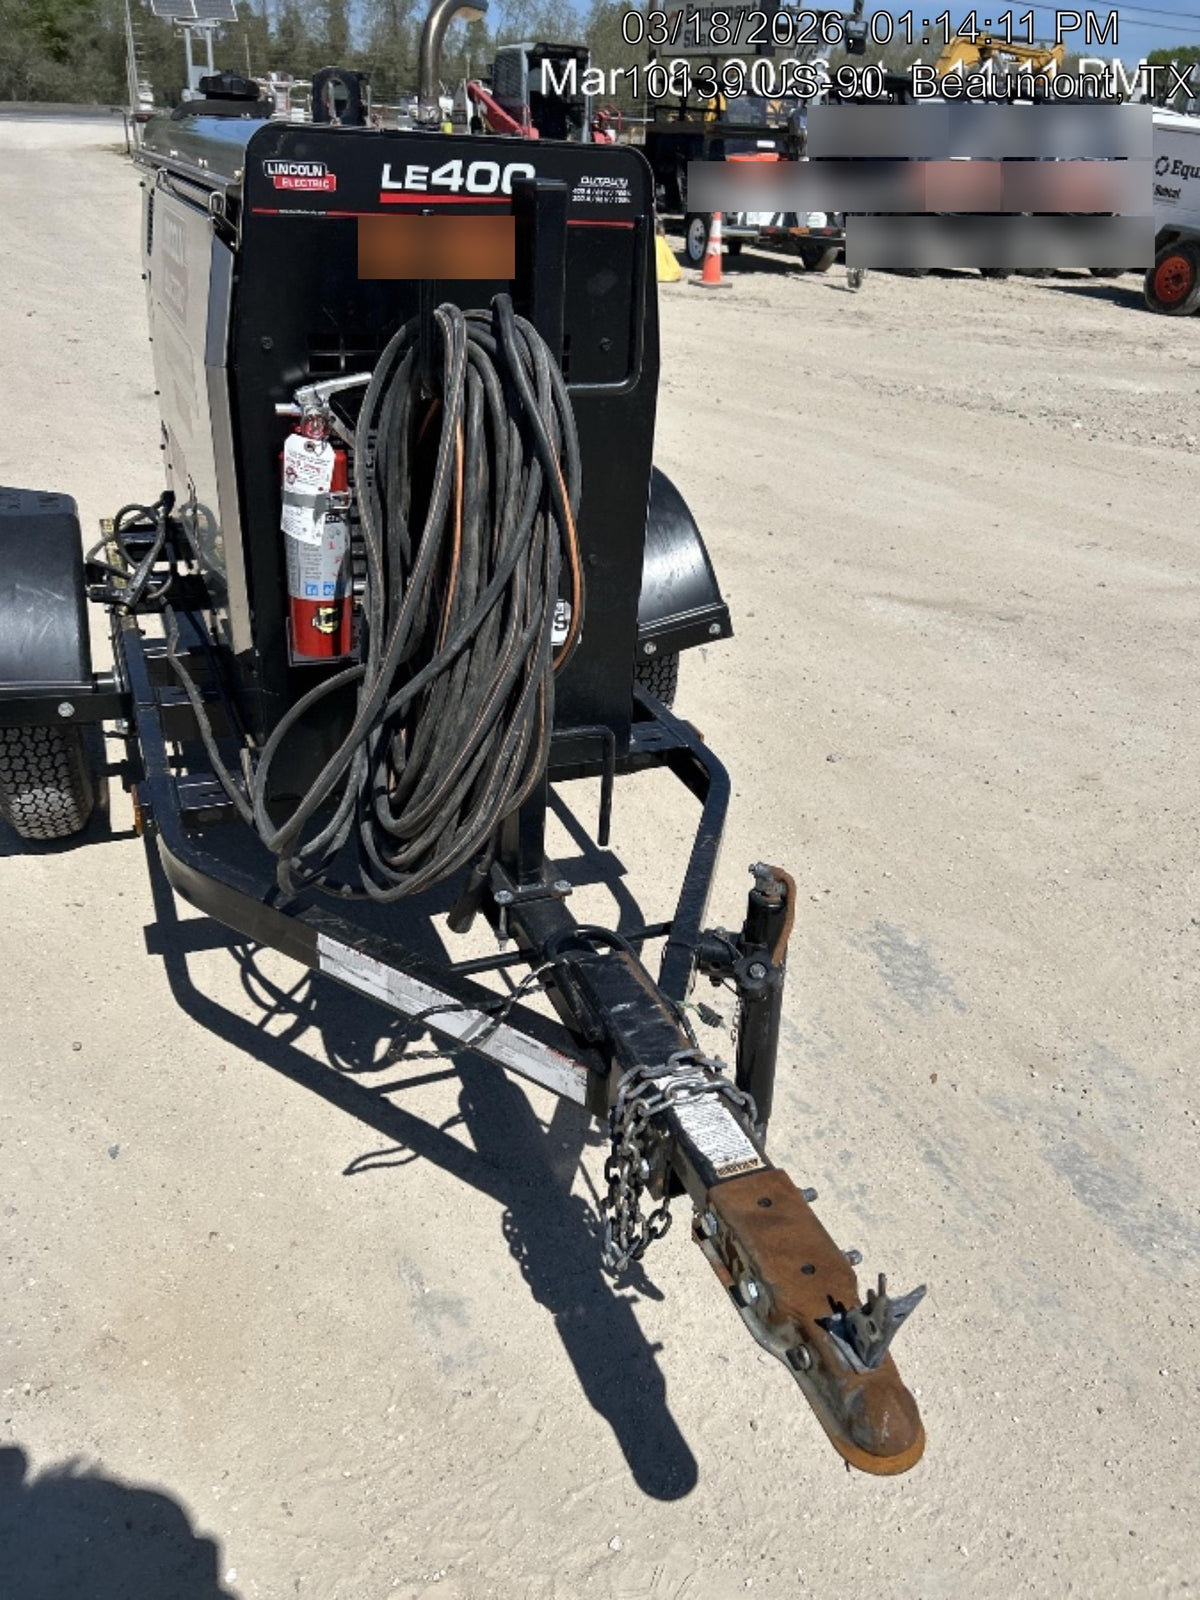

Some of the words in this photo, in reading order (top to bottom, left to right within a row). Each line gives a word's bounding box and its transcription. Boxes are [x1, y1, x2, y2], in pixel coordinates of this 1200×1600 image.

[267, 163, 323, 177] LINCOLN
[381, 159, 536, 195] LE400
[281, 177, 330, 189] ELECTRIC
